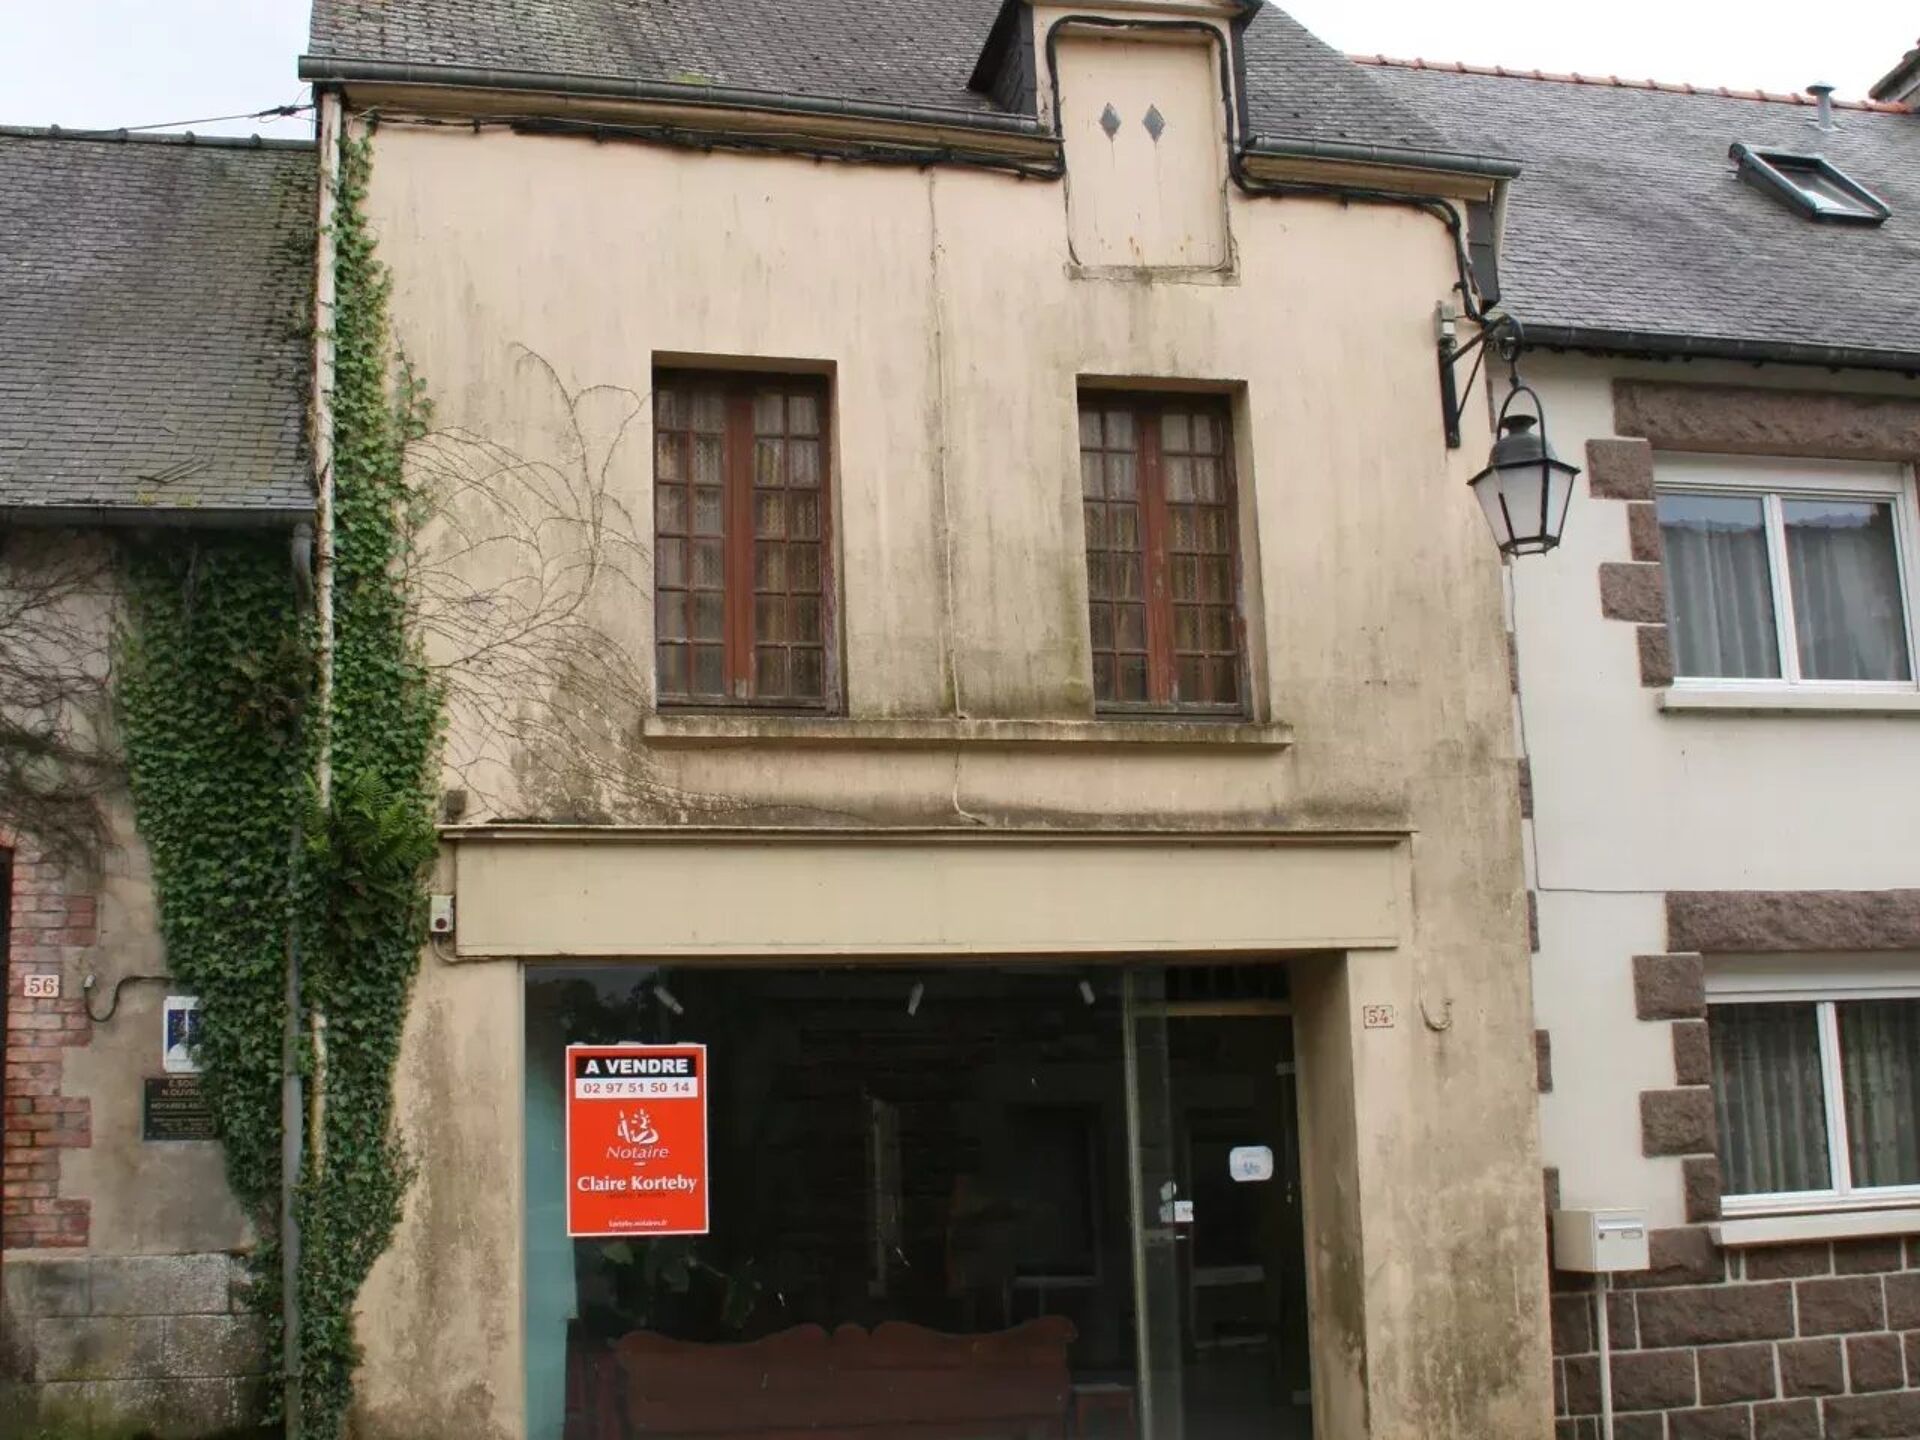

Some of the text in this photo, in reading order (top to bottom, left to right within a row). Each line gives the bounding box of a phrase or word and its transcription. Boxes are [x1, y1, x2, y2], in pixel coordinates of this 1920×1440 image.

[30, 977, 55, 994] 56
[1368, 1009, 1389, 1024] 54
[585, 1058, 689, 1075] A VENDRE
[583, 1082, 690, 1094] 02 97 51 50 14
[606, 1146, 670, 1160] Notaire
[577, 1173, 698, 1193] Claire Korteby
